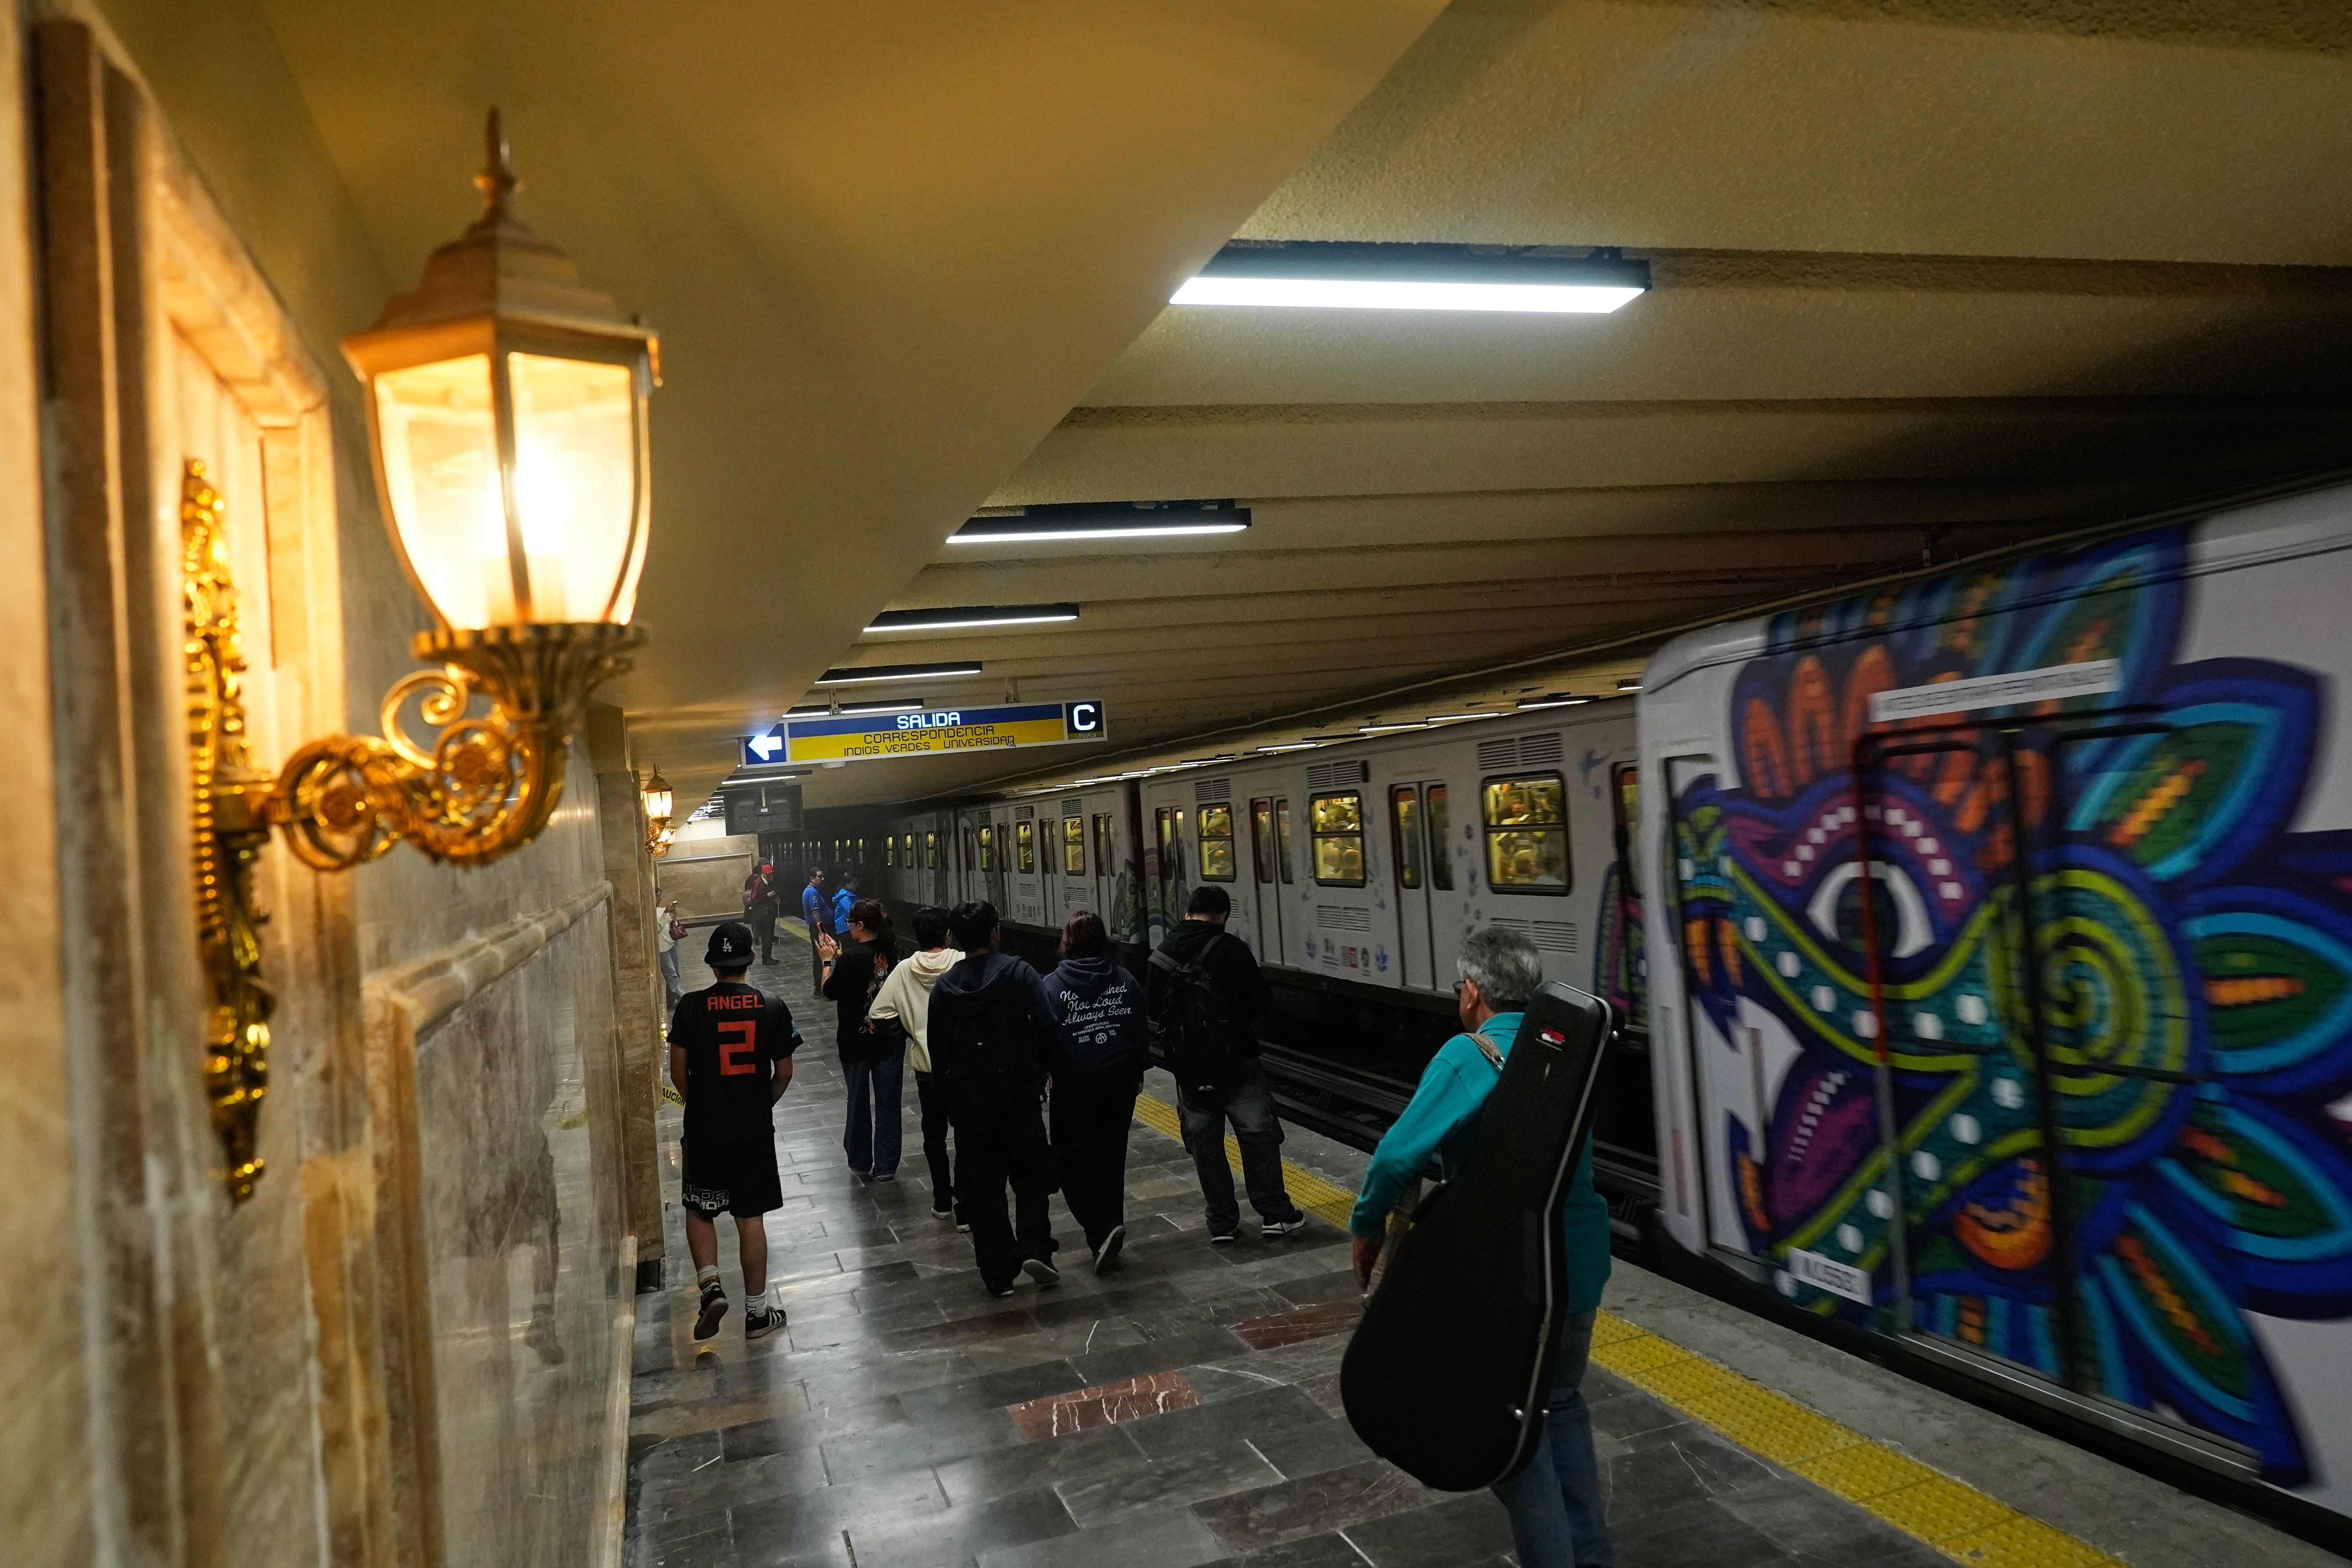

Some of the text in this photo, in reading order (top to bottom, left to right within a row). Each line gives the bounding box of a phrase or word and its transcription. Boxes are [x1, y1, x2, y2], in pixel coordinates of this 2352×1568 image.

[897, 712, 961, 729] SALIDA
[1073, 704, 1096, 731] C
[864, 726, 994, 744] CORRESPONDENCIA
[844, 735, 1015, 756] INDIOS VERDES UNIVERSIDAD
[723, 938, 732, 952] LA
[1060, 982, 1128, 1002] No shed
[707, 995, 764, 1011] ANGEL
[1068, 993, 1123, 1012] Not Loud
[1062, 1005, 1132, 1025] Always Seen
[718, 1020, 756, 1075] 2
